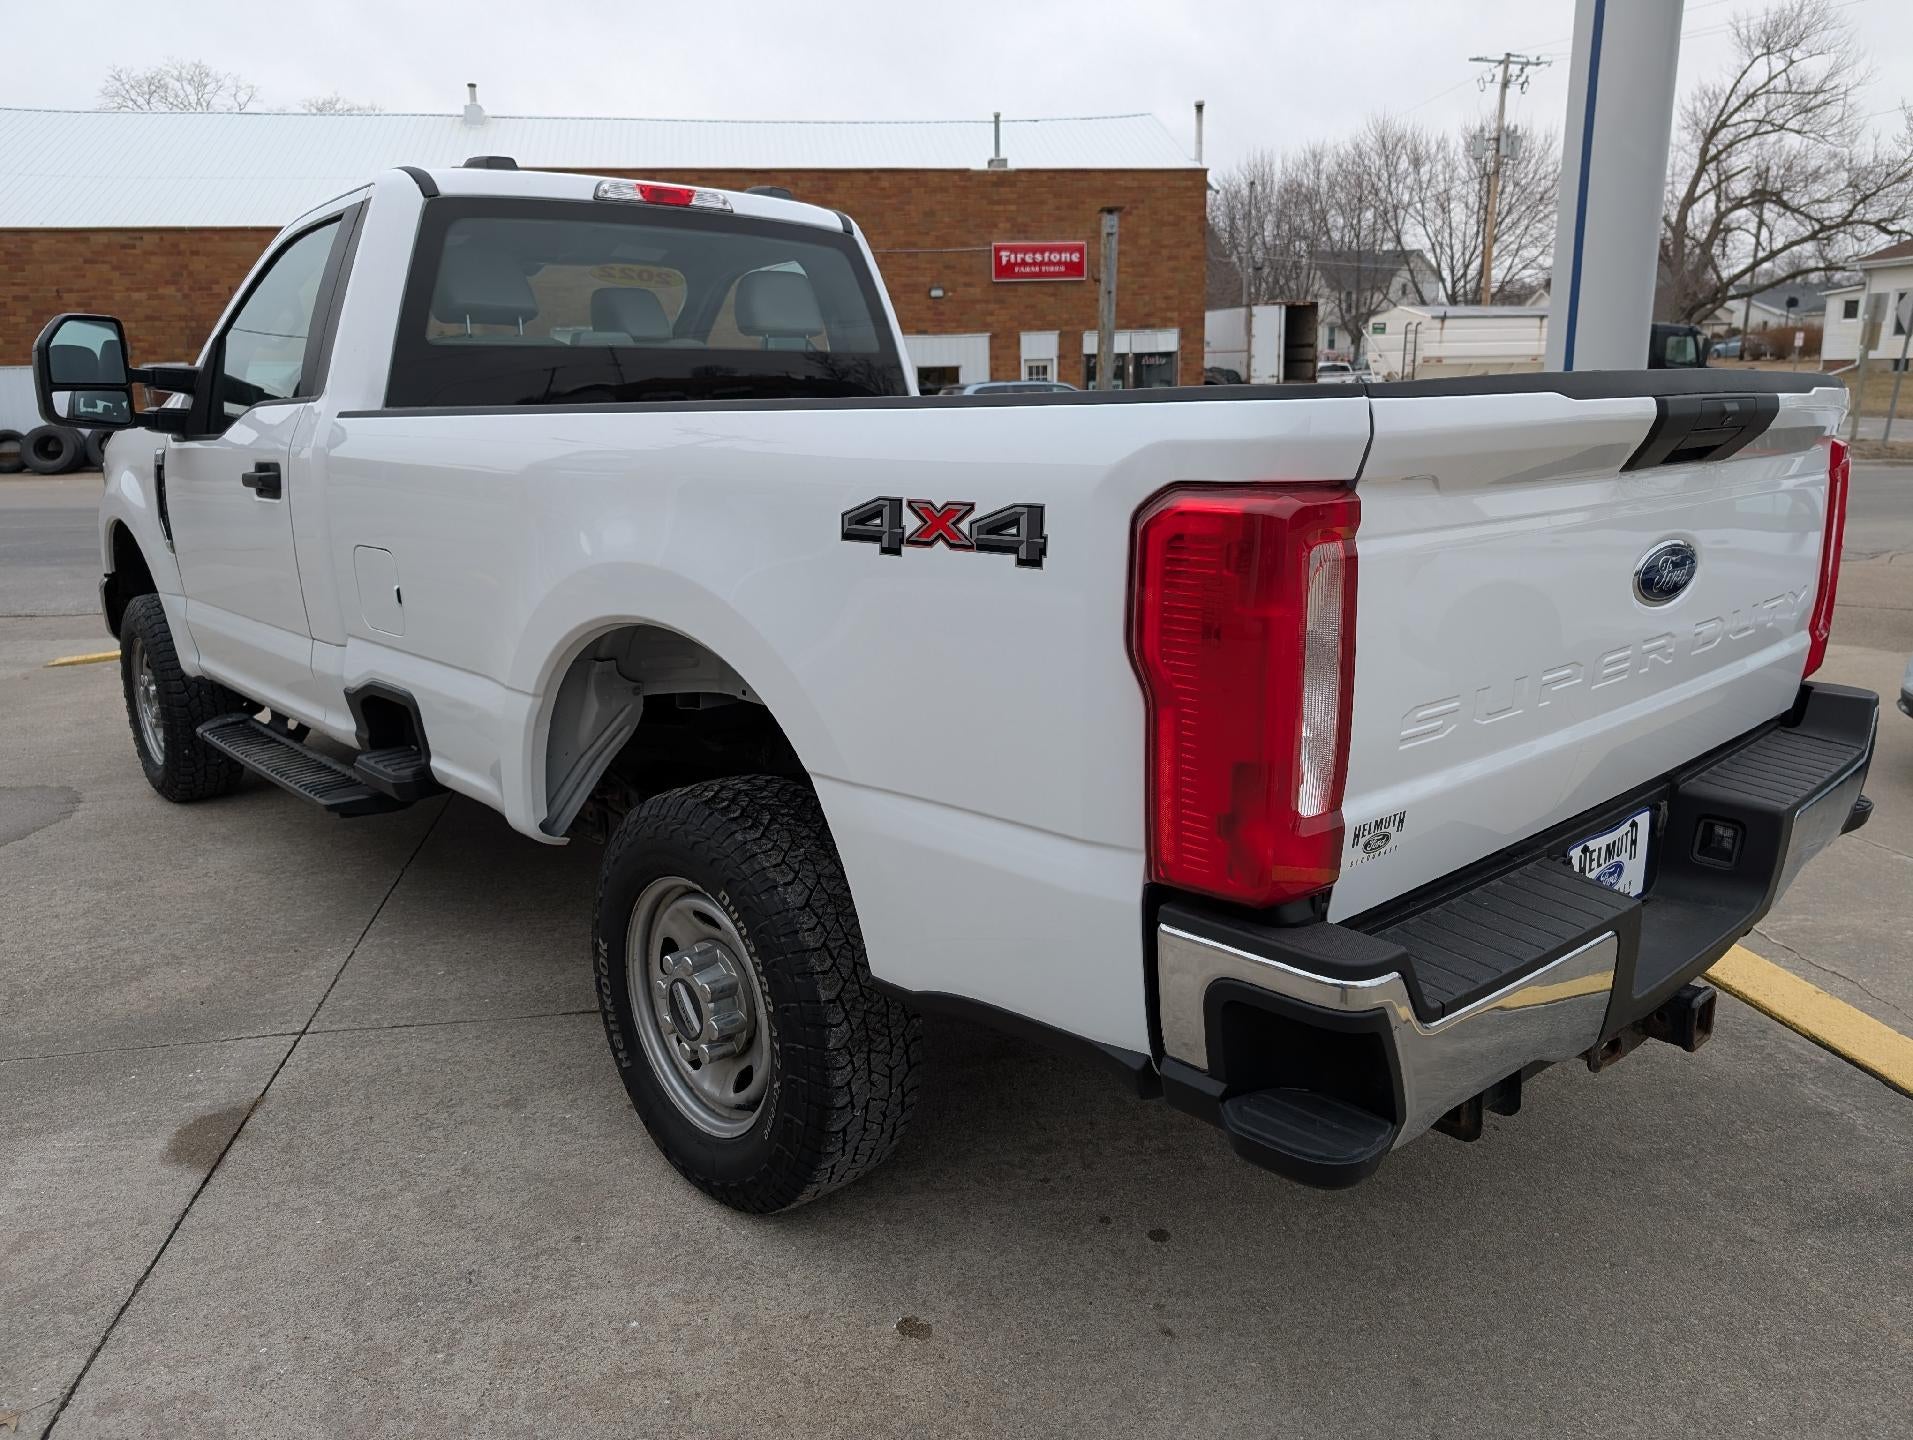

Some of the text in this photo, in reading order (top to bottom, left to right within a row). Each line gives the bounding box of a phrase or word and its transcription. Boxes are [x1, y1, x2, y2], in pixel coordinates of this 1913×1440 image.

[999, 250, 1080, 266] Firestone
[1652, 554, 1690, 593] Ford
[1399, 585, 1808, 751] SUPER DUTY
[1351, 810, 1406, 848] HELMUTH
[1578, 819, 1639, 875] HELMUTH
